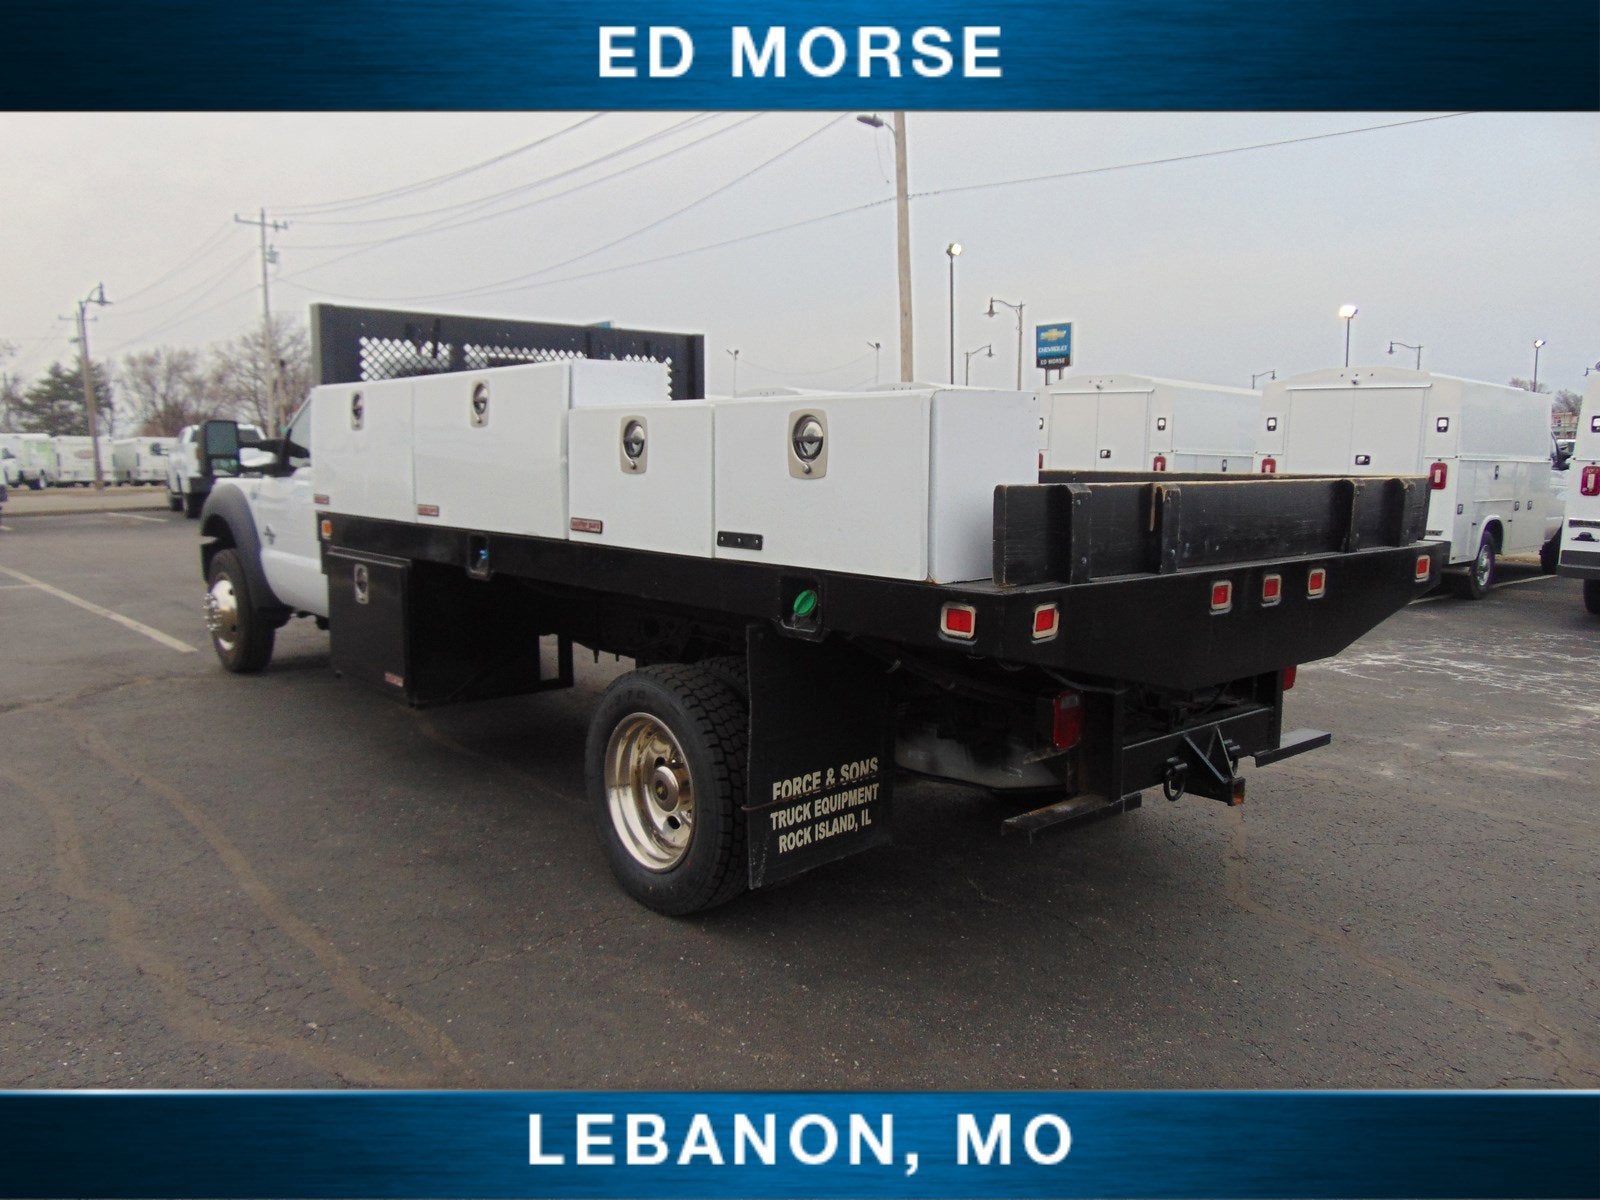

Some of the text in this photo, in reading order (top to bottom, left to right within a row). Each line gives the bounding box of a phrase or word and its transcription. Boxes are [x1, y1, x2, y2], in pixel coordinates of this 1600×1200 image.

[772, 756, 879, 800] FORCE & SONS
[770, 783, 879, 831] TRUCK EQUIPMENT
[779, 808, 872, 854] ROCK ISLAND, IL
